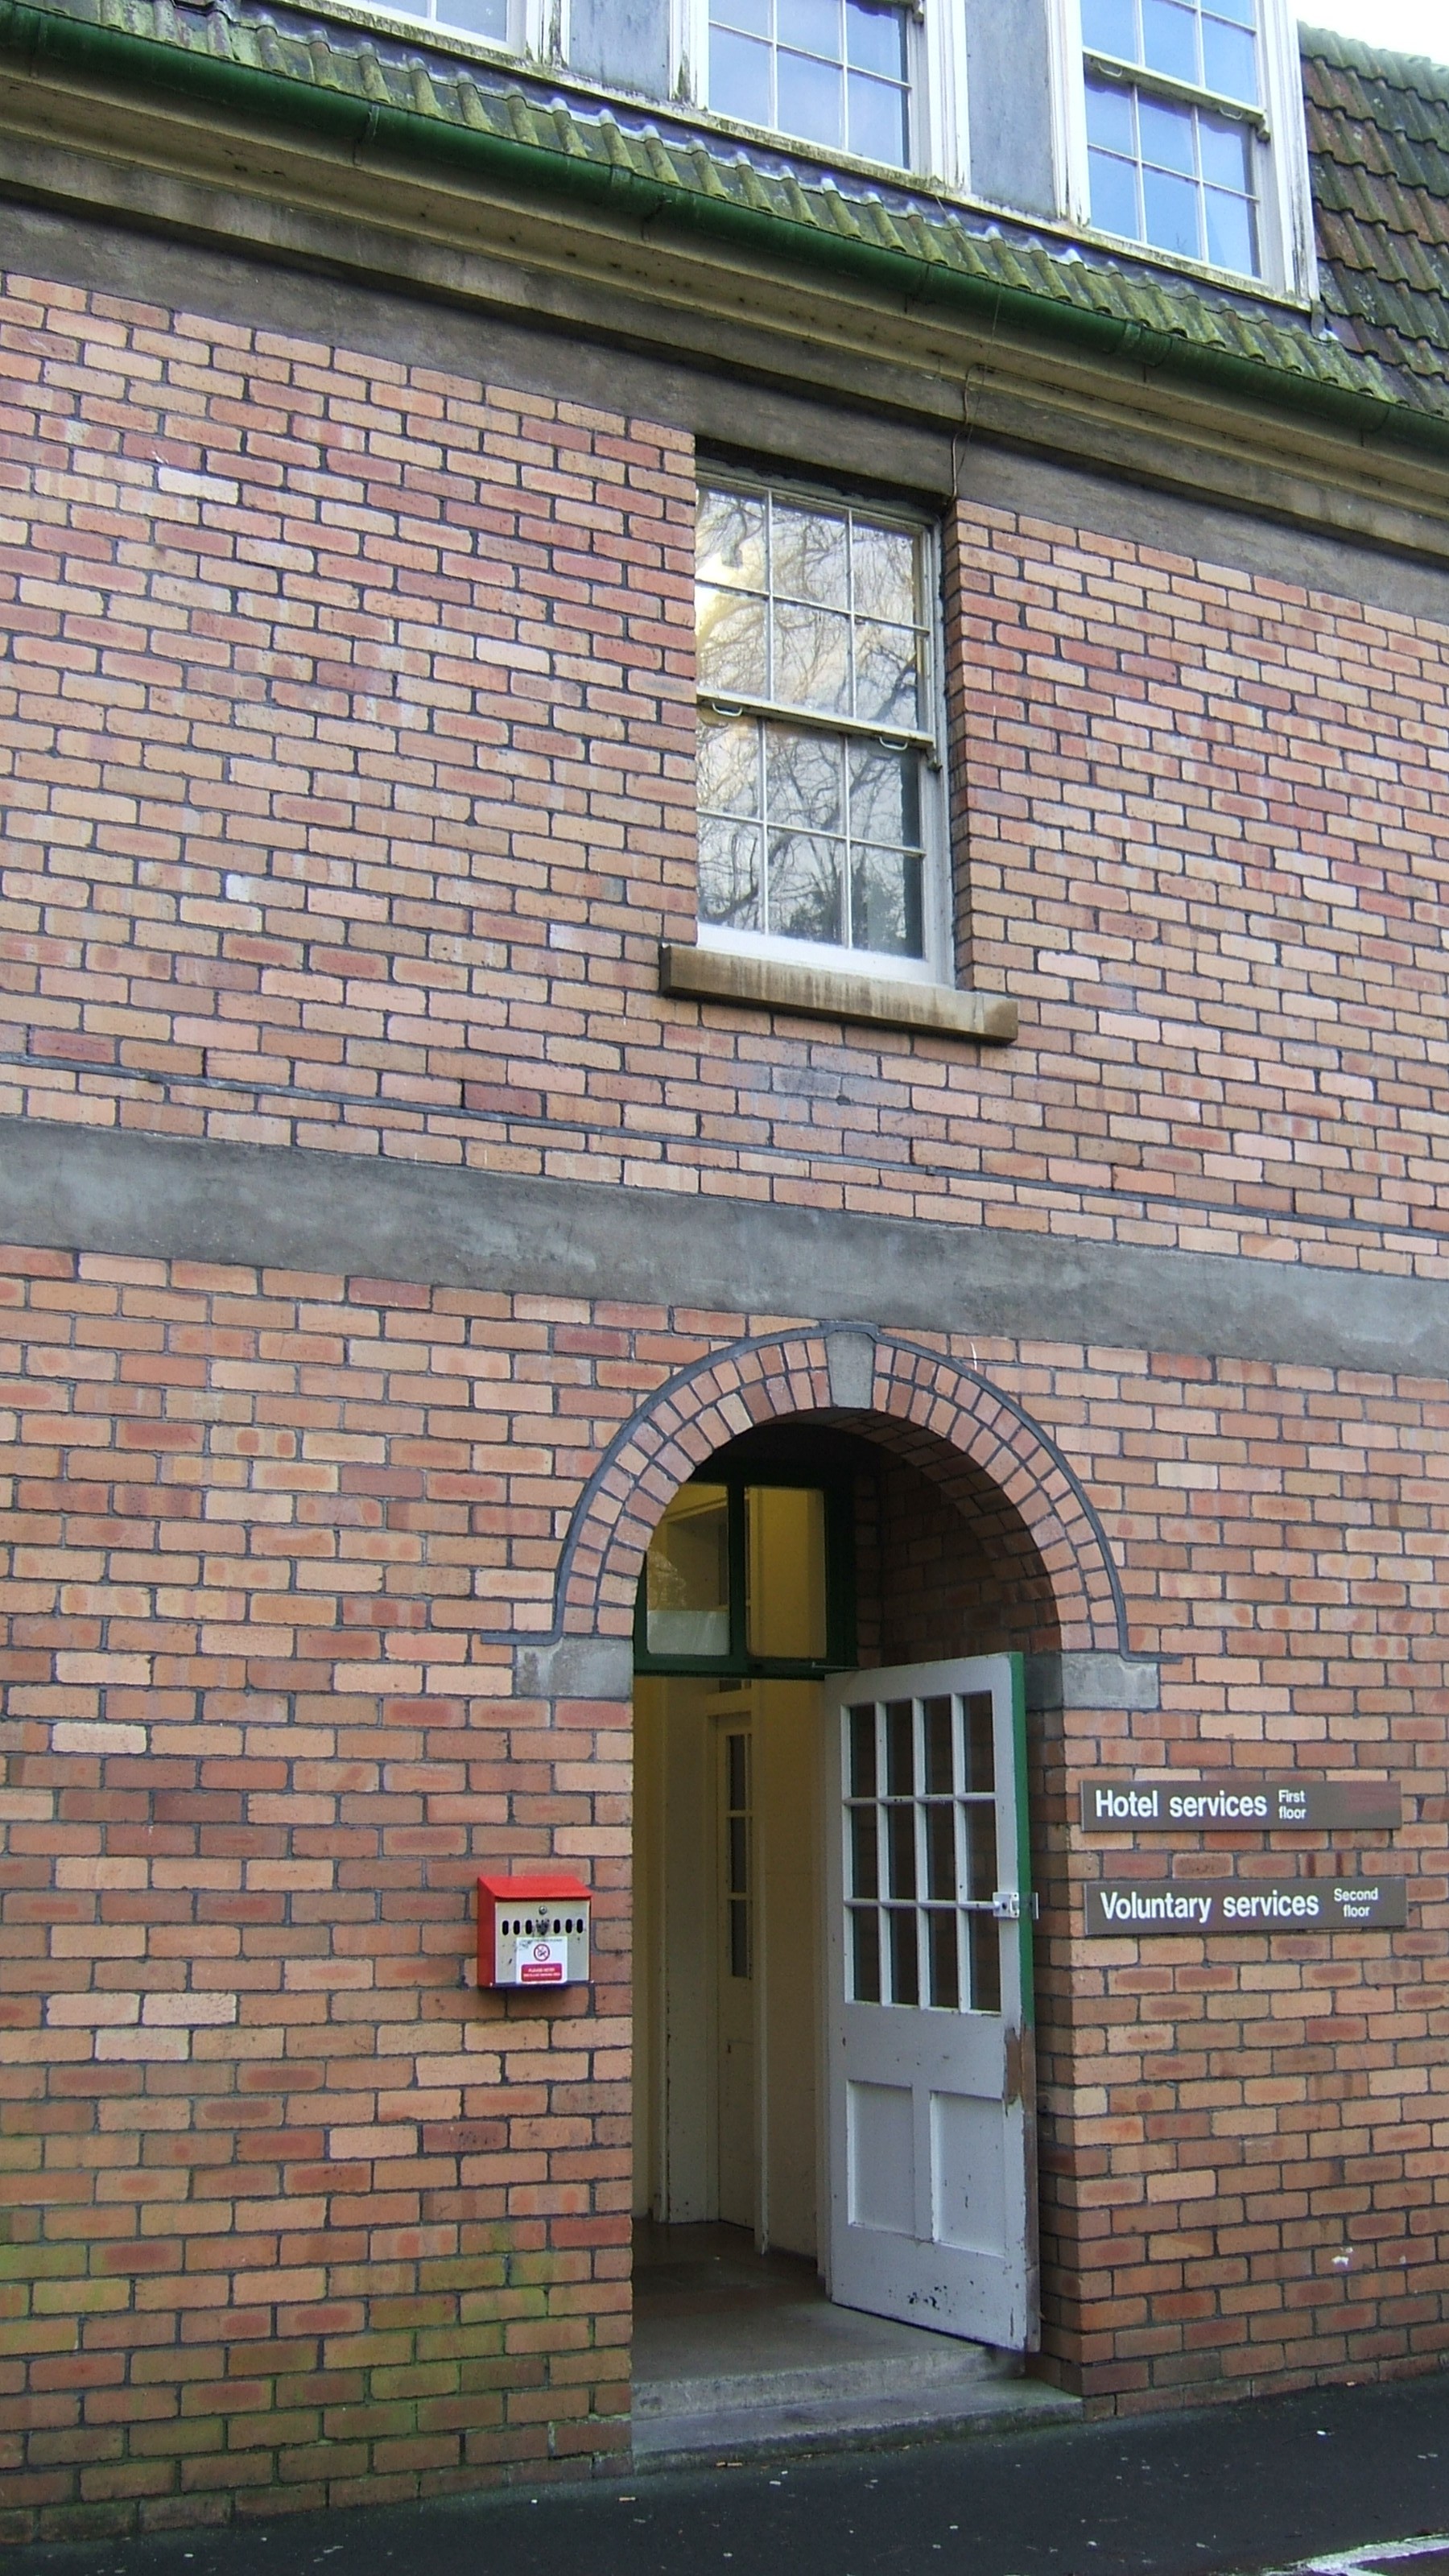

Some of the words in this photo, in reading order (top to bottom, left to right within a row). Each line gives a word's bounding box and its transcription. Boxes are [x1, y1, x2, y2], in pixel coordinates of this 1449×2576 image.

[1095, 1790, 1158, 1818] Hotel
[1169, 1790, 1267, 1818] services
[1278, 1790, 1306, 1804] First
[1278, 1806, 1307, 1819] floor
[1334, 1887, 1379, 1902] Second
[1100, 1891, 1212, 1923] Voluntary
[1222, 1889, 1319, 1918] services
[1343, 1903, 1370, 1918] floor
